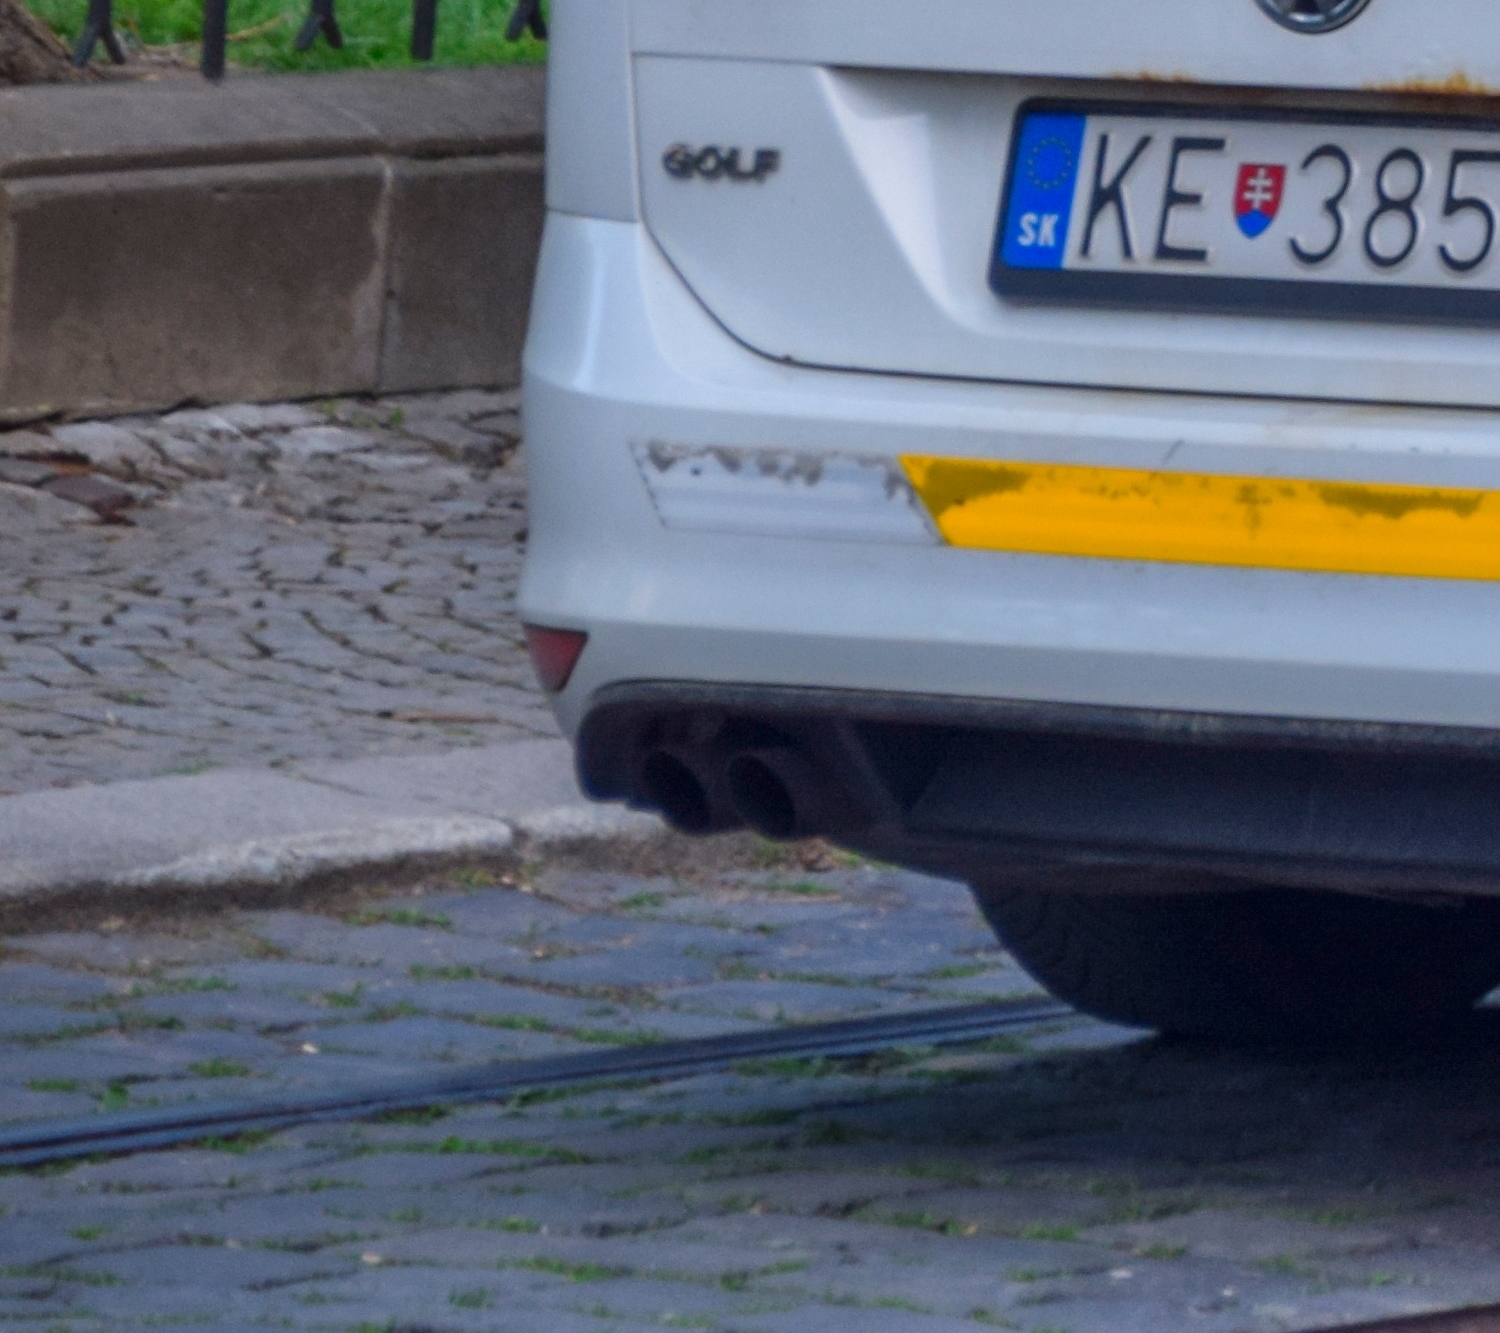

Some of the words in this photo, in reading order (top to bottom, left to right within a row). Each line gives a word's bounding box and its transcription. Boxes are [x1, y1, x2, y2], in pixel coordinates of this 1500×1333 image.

[662, 142, 781, 185] GOLF
[1081, 132, 1226, 263] KE
[1017, 213, 1058, 247] SK
